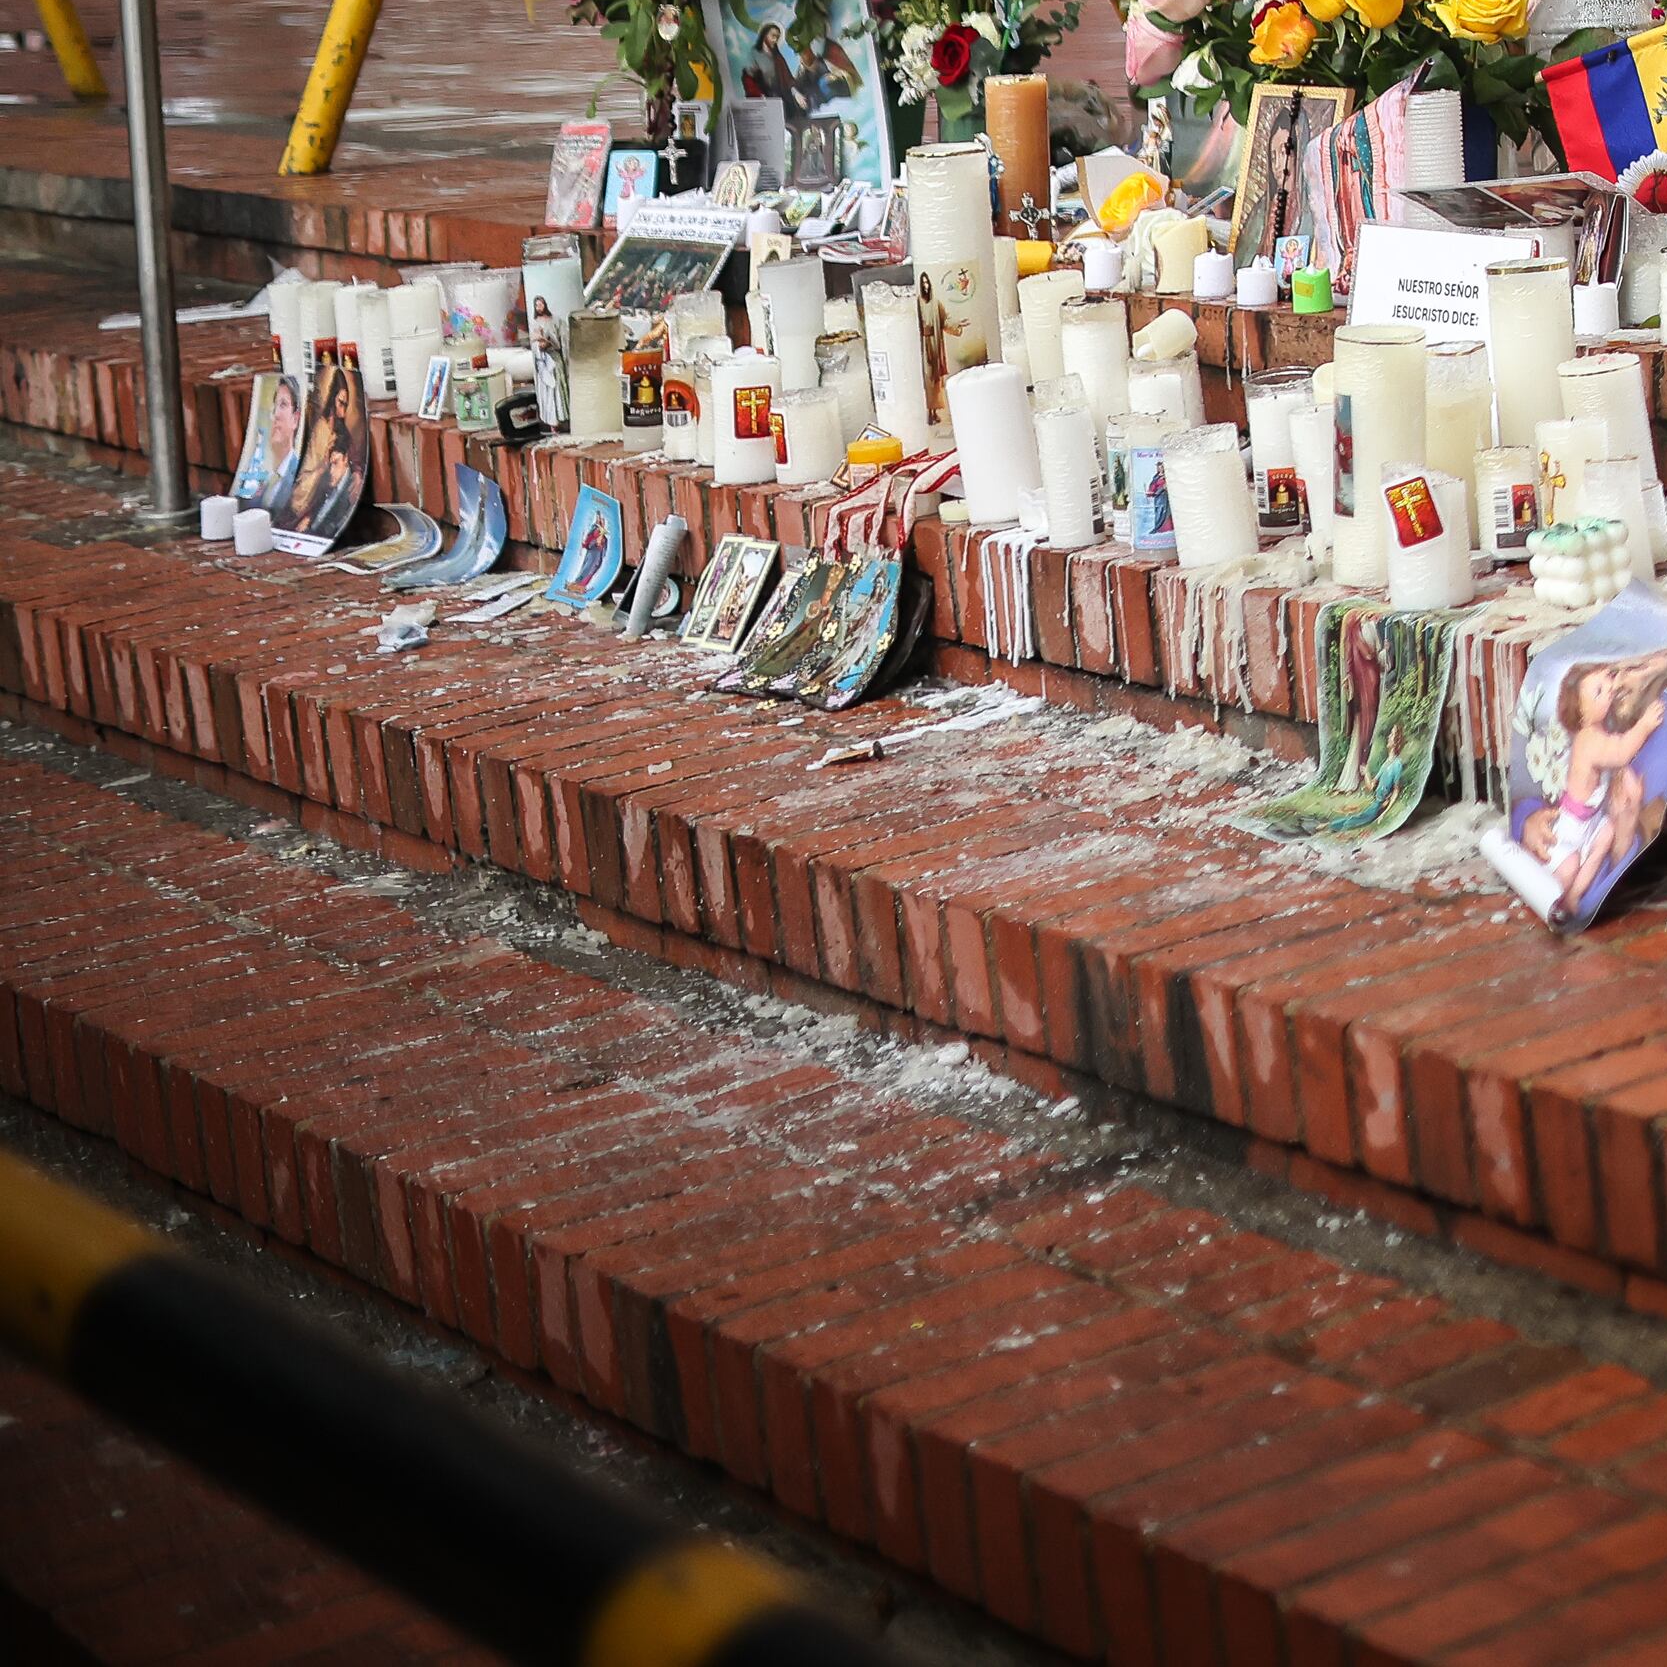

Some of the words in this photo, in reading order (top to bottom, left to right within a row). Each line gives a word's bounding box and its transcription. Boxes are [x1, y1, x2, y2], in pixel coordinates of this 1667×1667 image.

[1398, 278, 1442, 295] NUESTRO
[1444, 281, 1479, 299] SEÑOR
[1392, 305, 1450, 323] JESUCRISTO
[1452, 311, 1479, 326] DICE:
